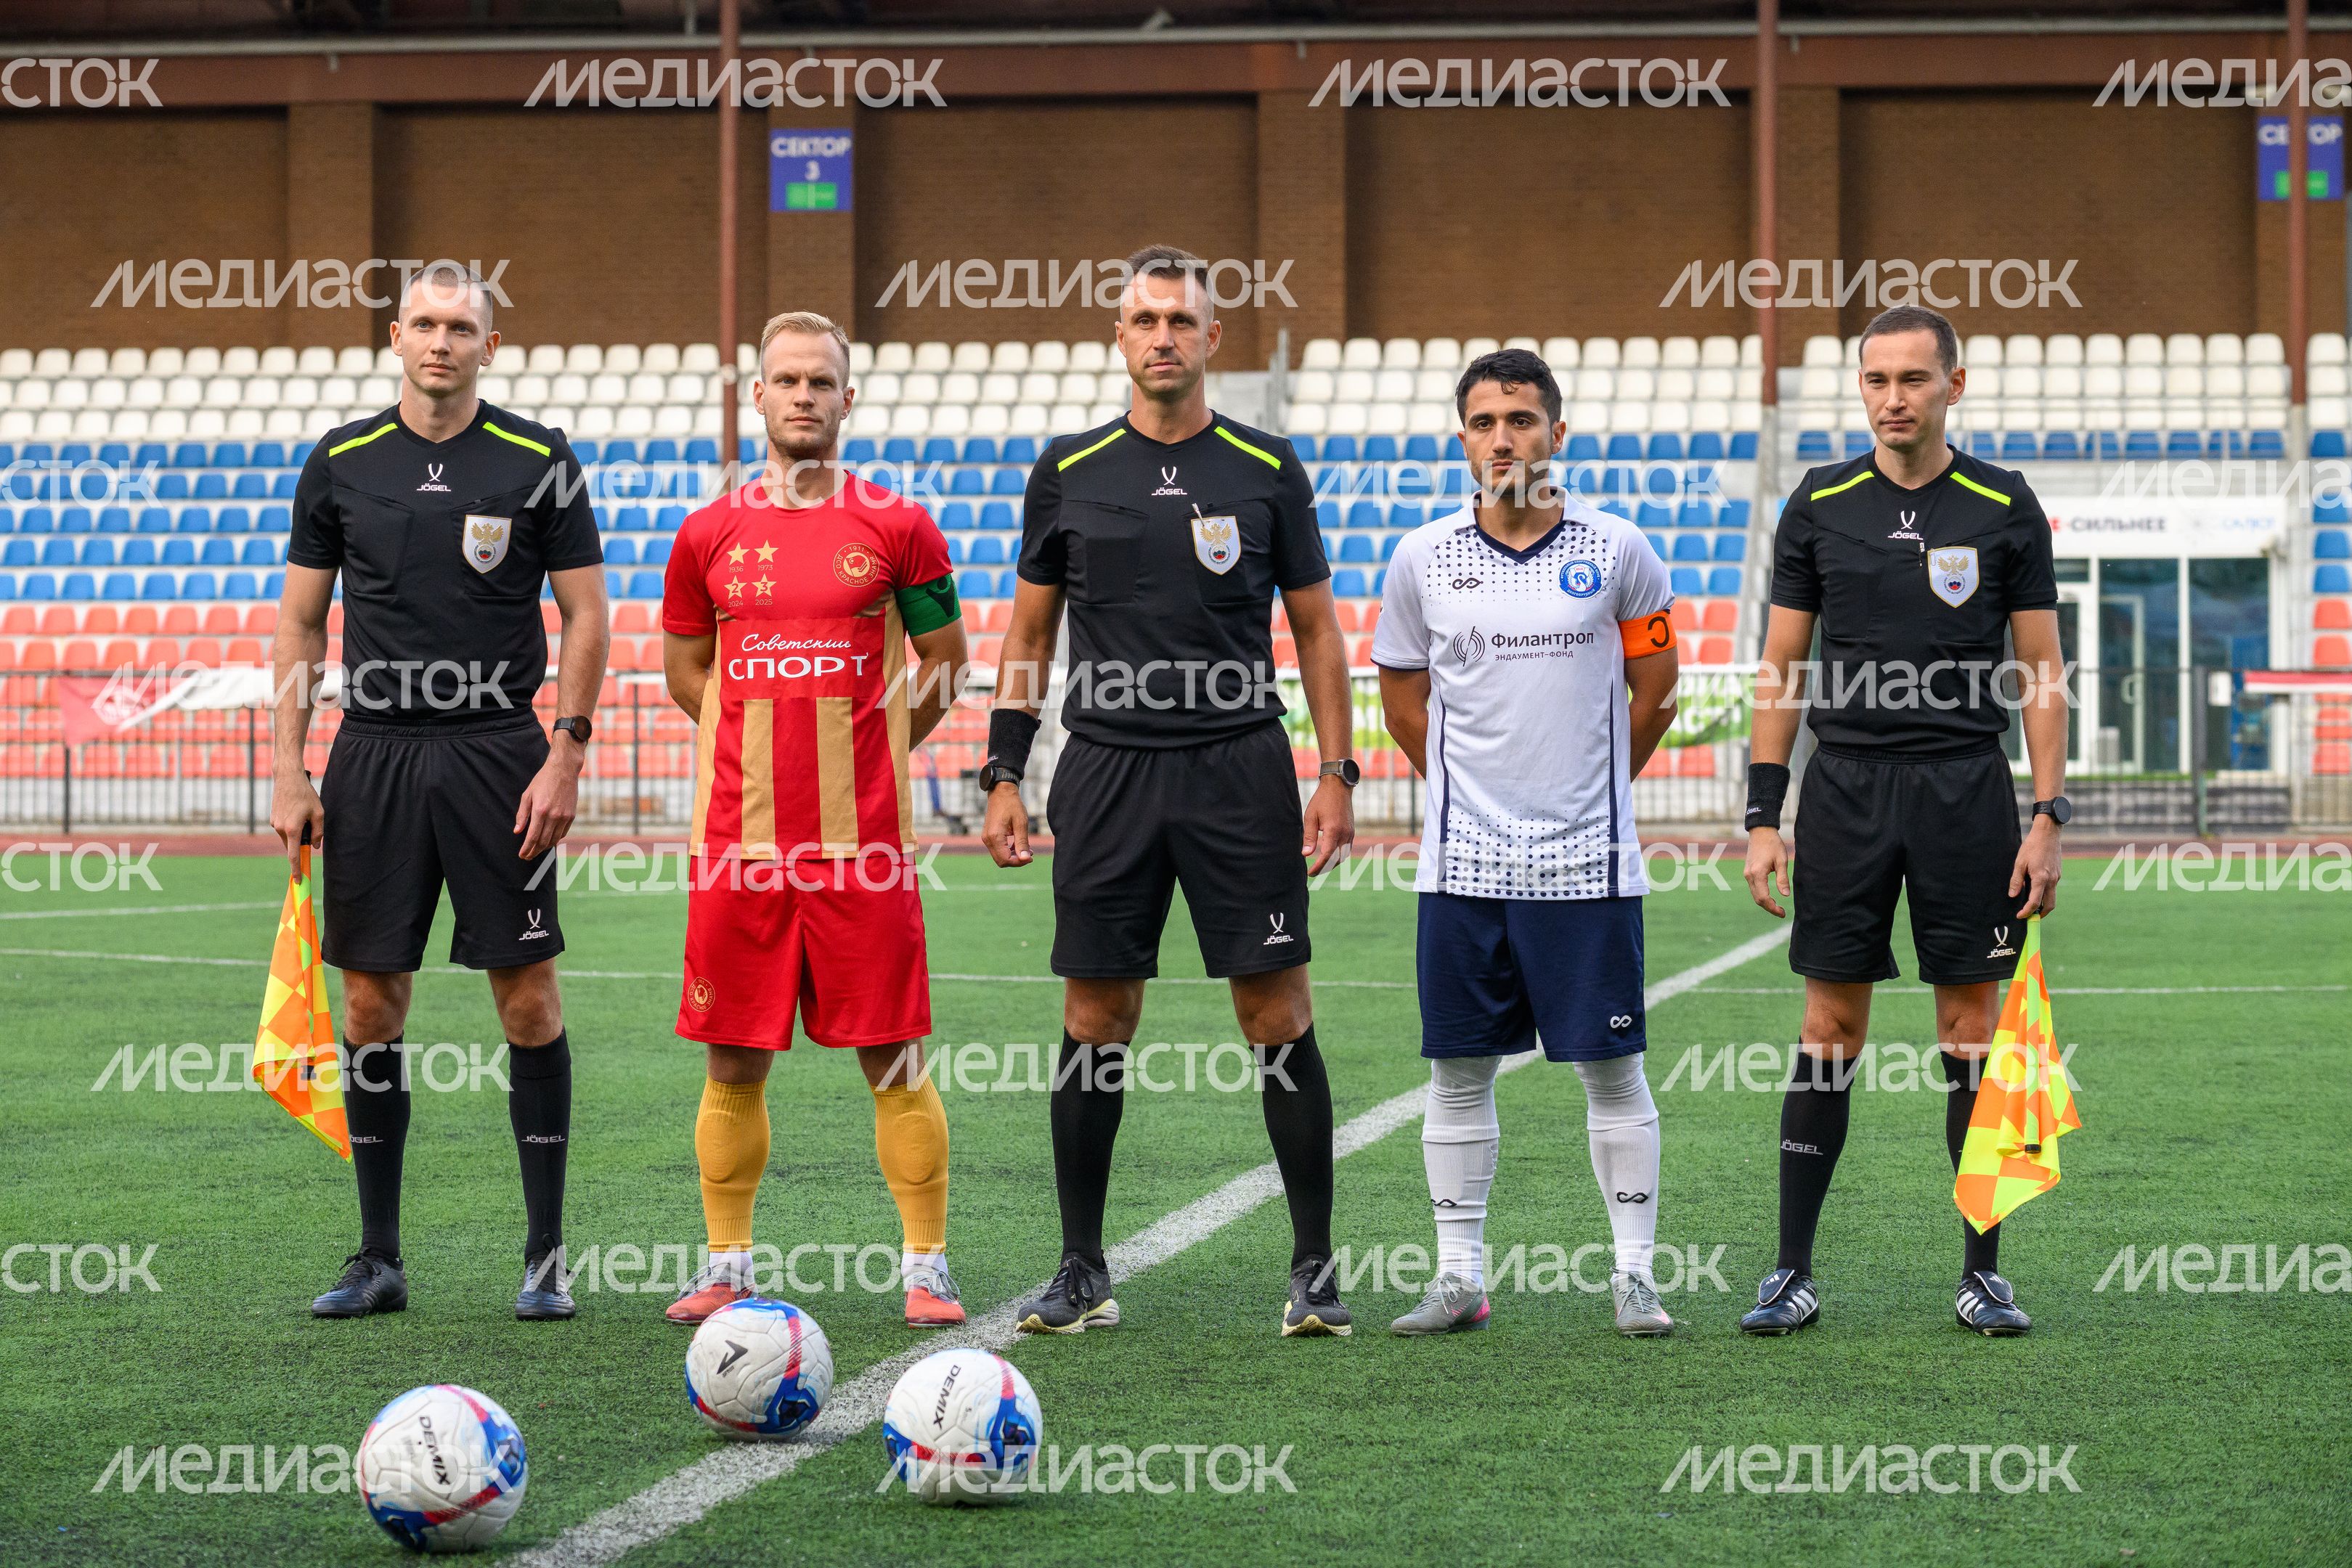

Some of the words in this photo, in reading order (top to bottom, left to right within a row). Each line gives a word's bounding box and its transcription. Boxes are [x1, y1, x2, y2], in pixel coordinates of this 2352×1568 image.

[770, 136, 851, 157] СЕКТОР
[805, 160, 821, 181] 3
[416, 483, 452, 492] JÖGEL
[1151, 487, 1188, 496] JÖGEL
[1887, 531, 1924, 540] JÖGEL
[838, 571, 869, 584] КРАСНОЕ
[731, 583, 739, 594] 2
[760, 581, 768, 592] 3
[1491, 632, 1595, 649] Филантроп
[518, 930, 550, 941] JÖGEL
[1263, 935, 1294, 945] JÖGEL
[1986, 947, 2017, 958] JÖGEL
[350, 1134, 384, 1143] ÖGEL
[521, 1134, 566, 1143] JÖGEL
[933, 1365, 961, 1429] DEMIX
